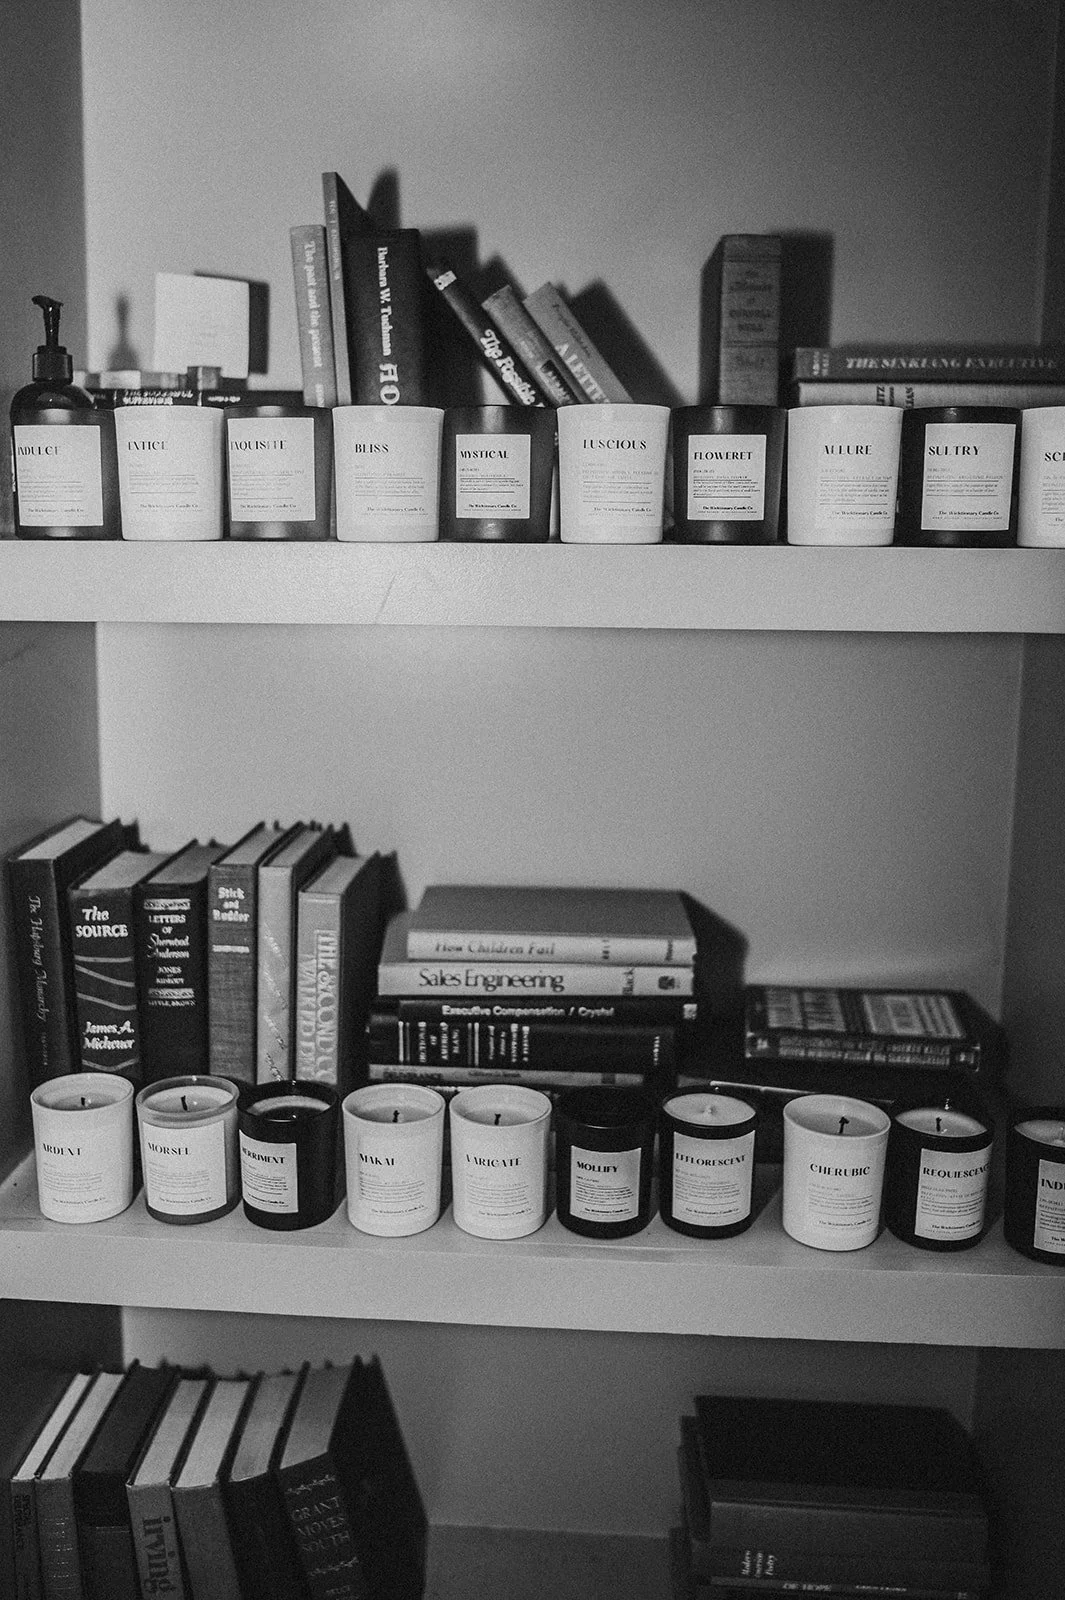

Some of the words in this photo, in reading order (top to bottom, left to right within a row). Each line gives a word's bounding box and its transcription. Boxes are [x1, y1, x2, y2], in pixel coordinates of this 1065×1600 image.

[377, 247, 389, 287] Barbara
[380, 288, 390, 303] W.
[381, 305, 393, 356] Tuchman
[480, 328, 506, 362] The
[498, 357, 536, 405] Possible
[355, 444, 389, 453] BLISS
[583, 439, 647, 450] LUSCIOUS
[824, 445, 872, 455] ALLURE
[928, 446, 980, 456] SULTRY
[460, 450, 509, 459] MYSTICAL
[694, 451, 753, 460] FLOWERET
[1044, 452, 1065, 462] SC
[218, 887, 245, 900] Stick
[223, 900, 239, 909] and
[81, 905, 110, 921] The
[148, 914, 186, 924] LETTERS
[212, 909, 250, 922] Rudder
[75, 924, 129, 938] SOURCE
[162, 926, 173, 934] OF
[150, 933, 190, 947] Sherwood
[317, 934, 337, 969] THE
[469, 940, 524, 955] Children
[528, 942, 555, 956] Fail
[419, 968, 461, 988] Sales
[464, 970, 565, 993] Engineering
[622, 967, 635, 995] Black
[35, 969, 50, 1022] Monarchy
[441, 1005, 491, 1016] Executive
[493, 1005, 565, 1018] Compensation
[82, 1020, 118, 1035] James
[118, 1020, 135, 1035] A.
[83, 1036, 135, 1050] Michener
[576, 1160, 619, 1173] MOLLIFY
[809, 1163, 871, 1177] CHERUBIC
[1040, 1178, 1065, 1191] IND
[142, 1515, 177, 1594] irving
